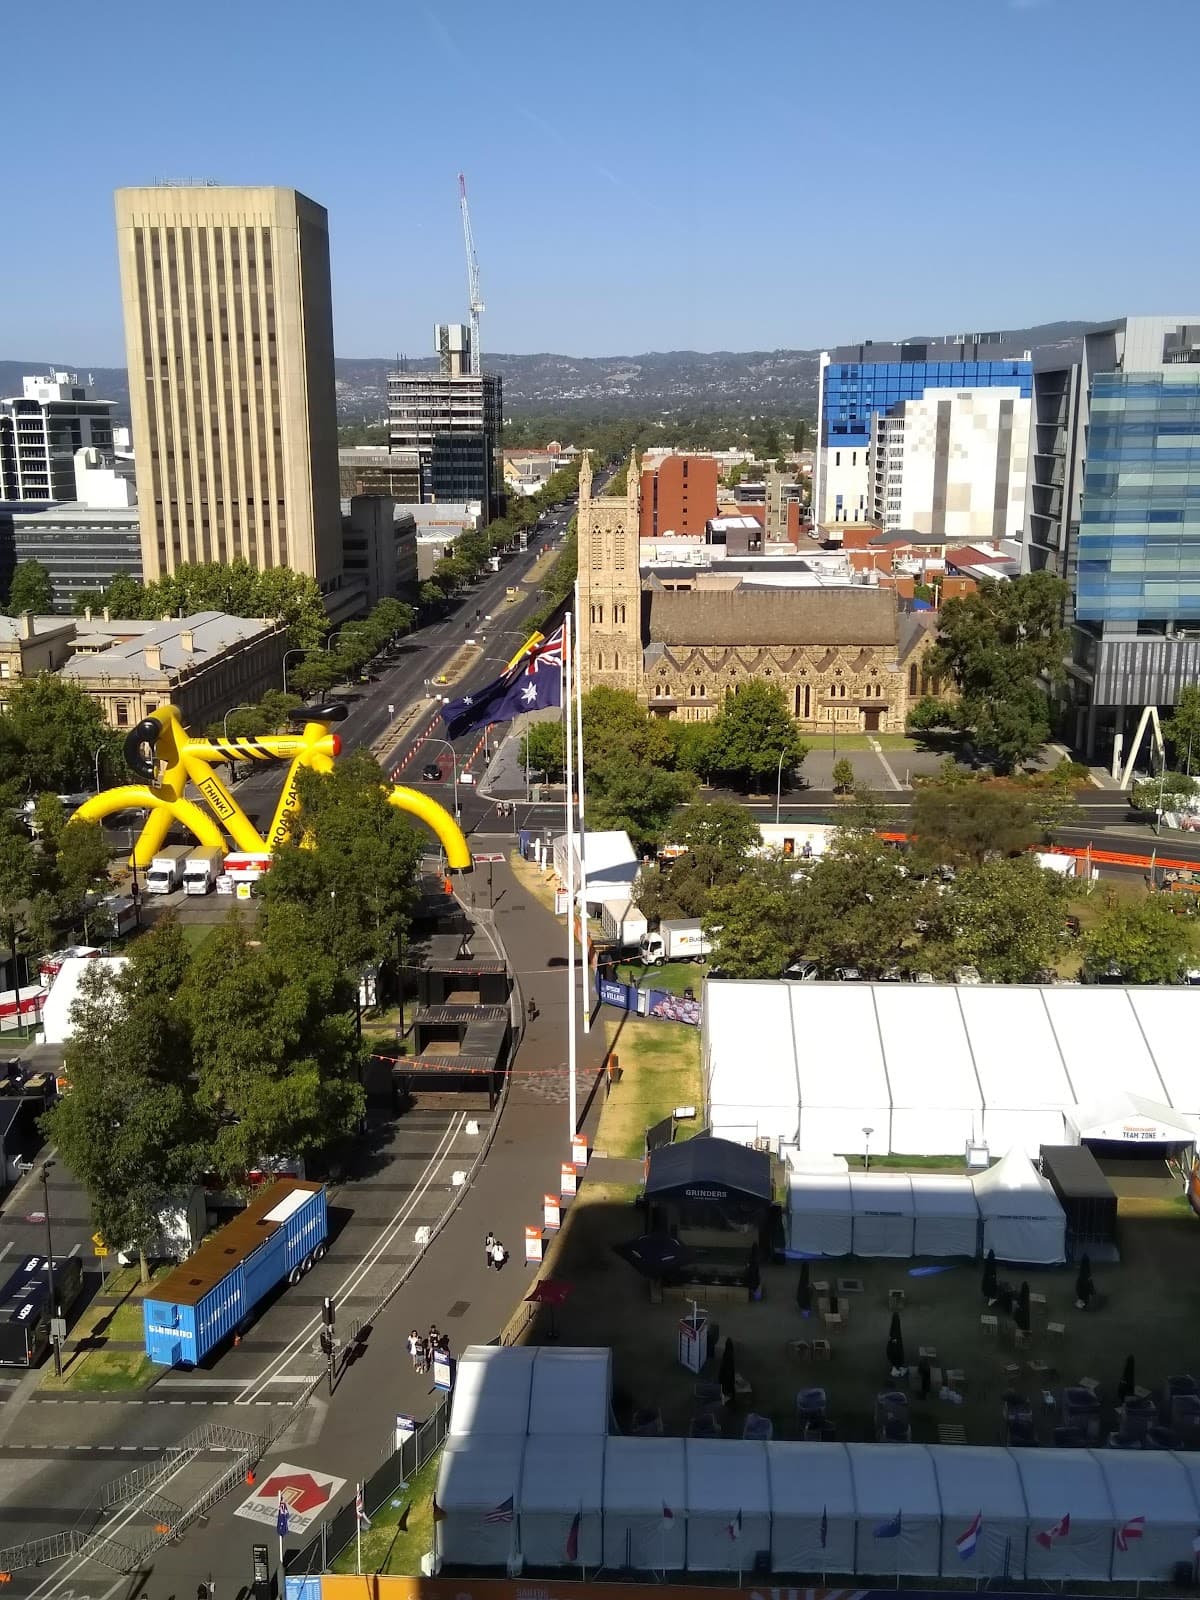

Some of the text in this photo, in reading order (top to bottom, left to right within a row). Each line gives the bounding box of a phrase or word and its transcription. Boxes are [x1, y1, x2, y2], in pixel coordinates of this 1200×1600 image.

[204, 783, 228, 815] THINK!
[272, 808, 291, 846] ROAD
[1123, 1131, 1157, 1140] TEAM ZONE
[685, 1189, 728, 1198] GRINDERS
[148, 1324, 193, 1339] SHIMANO
[241, 1501, 312, 1527] ADELIDE
